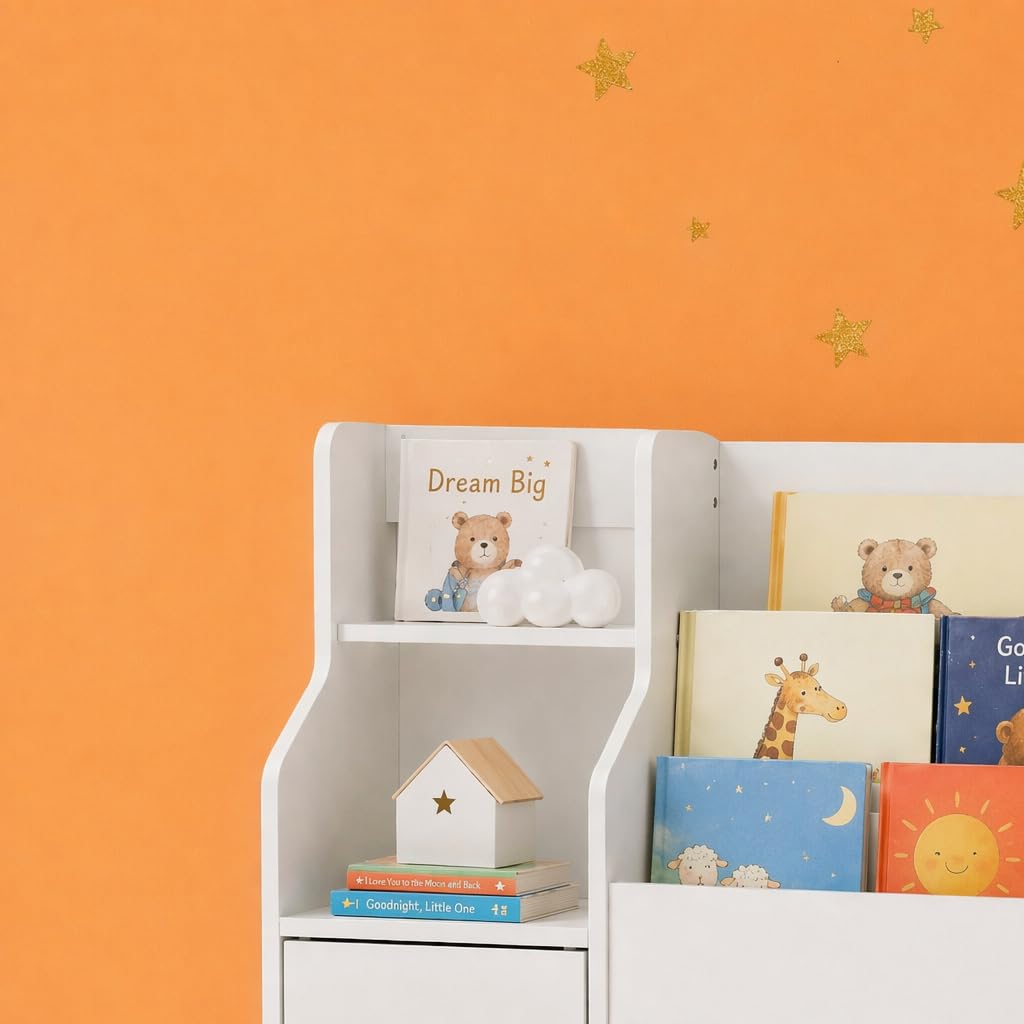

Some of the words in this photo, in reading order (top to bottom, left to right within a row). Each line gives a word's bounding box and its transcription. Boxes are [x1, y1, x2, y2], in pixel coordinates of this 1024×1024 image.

[428, 468, 500, 493] Dream
[511, 469, 546, 501] Big
[387, 878, 401, 886] You
[425, 879, 446, 888] Moon
[447, 880, 461, 889] and
[463, 881, 480, 889] Back
[366, 898, 423, 914] Goodnight,
[425, 901, 452, 913] Little
[454, 902, 475, 914] One
